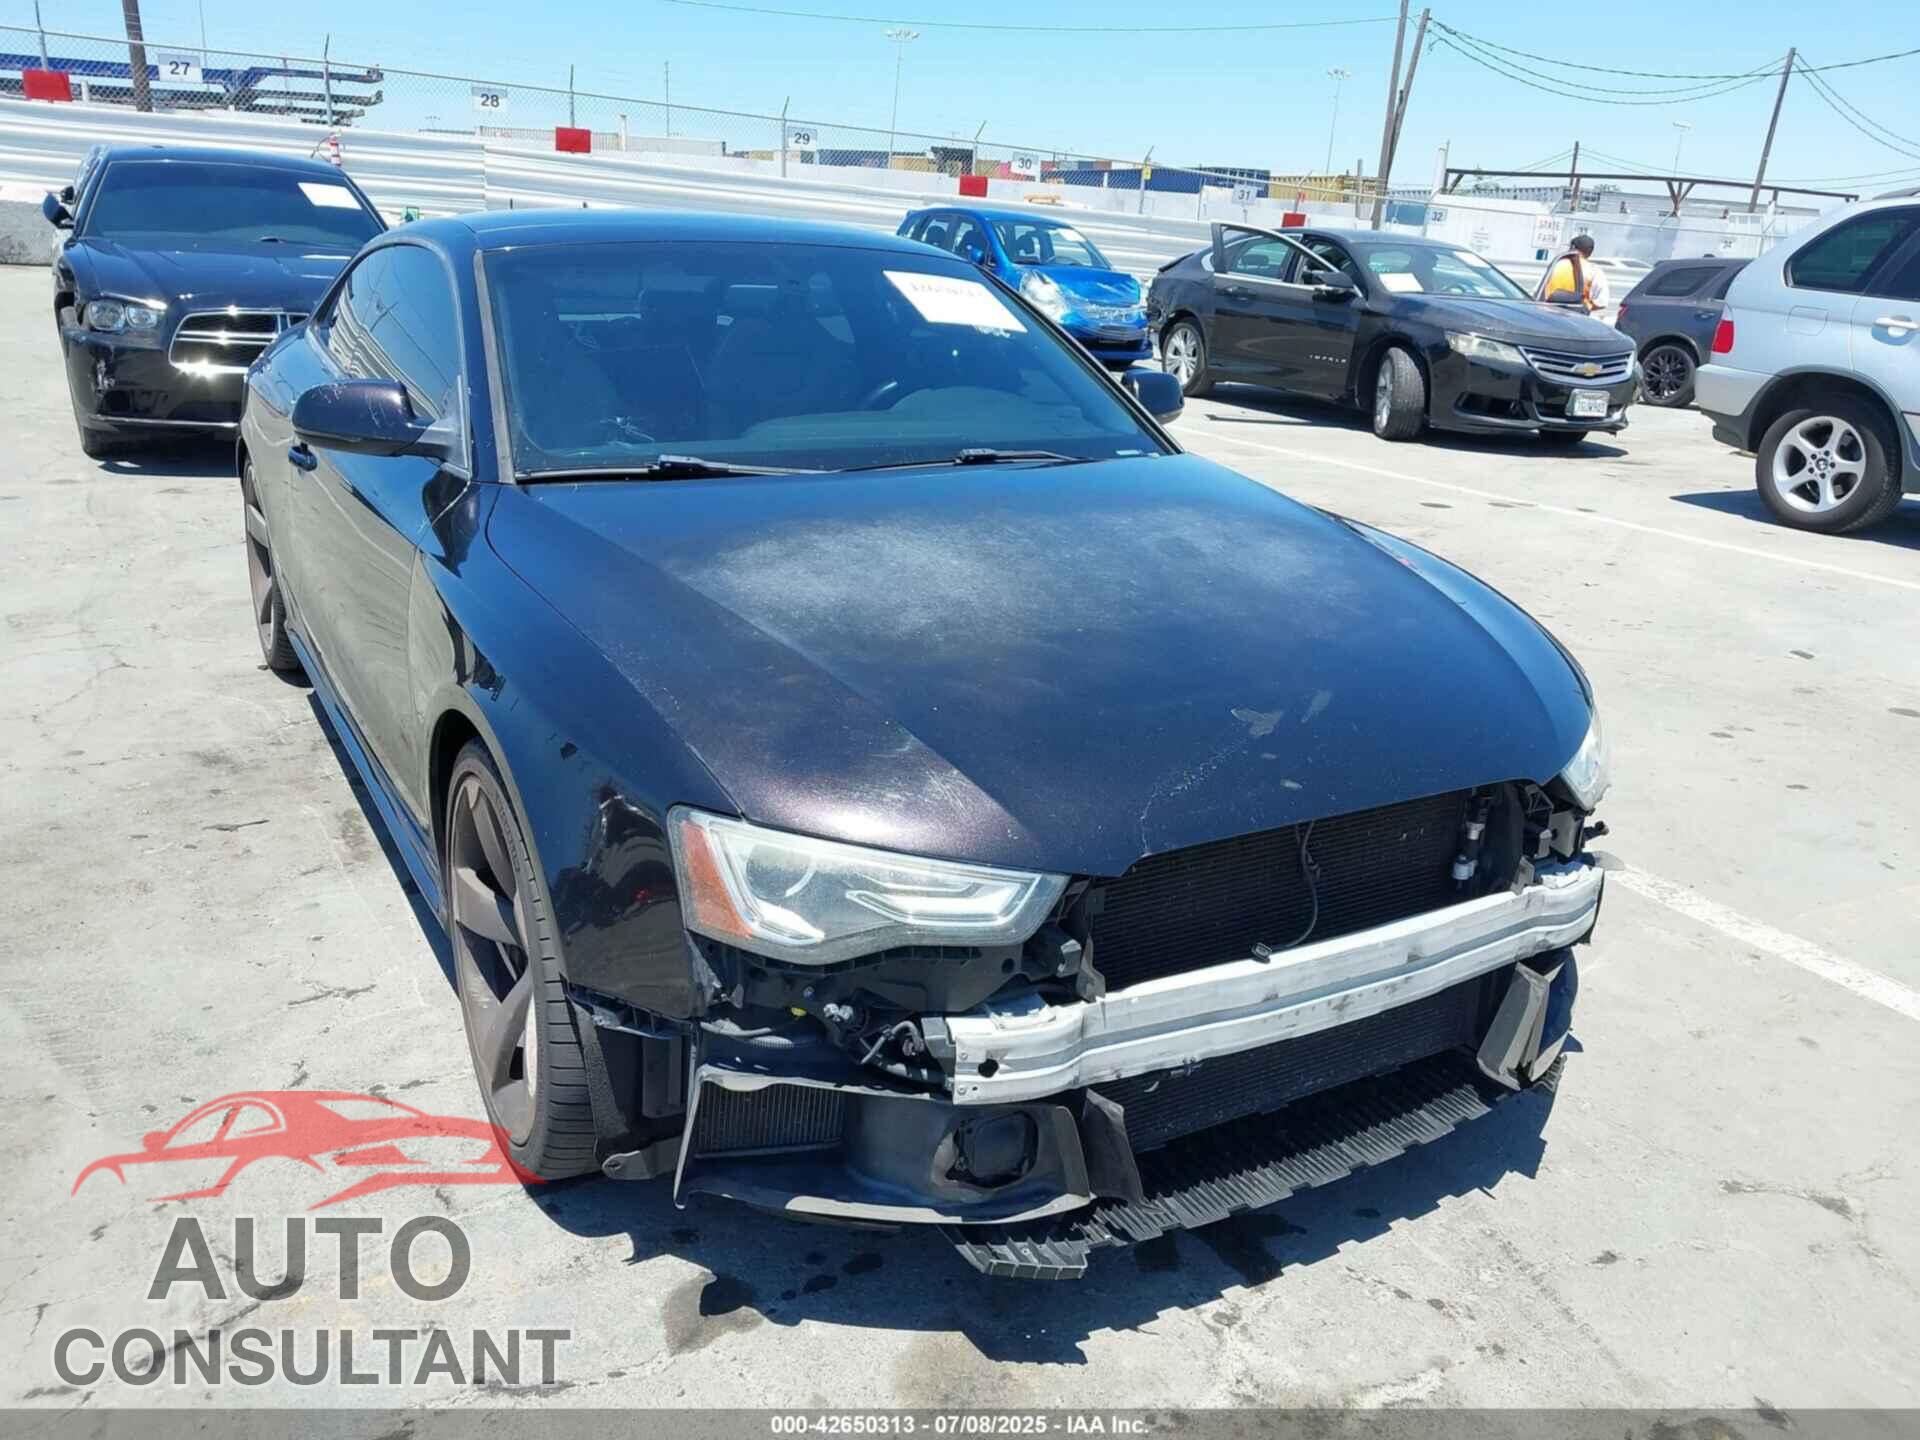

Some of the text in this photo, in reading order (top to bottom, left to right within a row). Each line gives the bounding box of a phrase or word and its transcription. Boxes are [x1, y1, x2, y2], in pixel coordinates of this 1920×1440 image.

[169, 60, 191, 76] 27
[480, 93, 500, 108] 28
[794, 132, 811, 145] 29
[1018, 157, 1032, 170] 30
[1238, 188, 1251, 200] 31
[1431, 211, 1444, 222] 32
